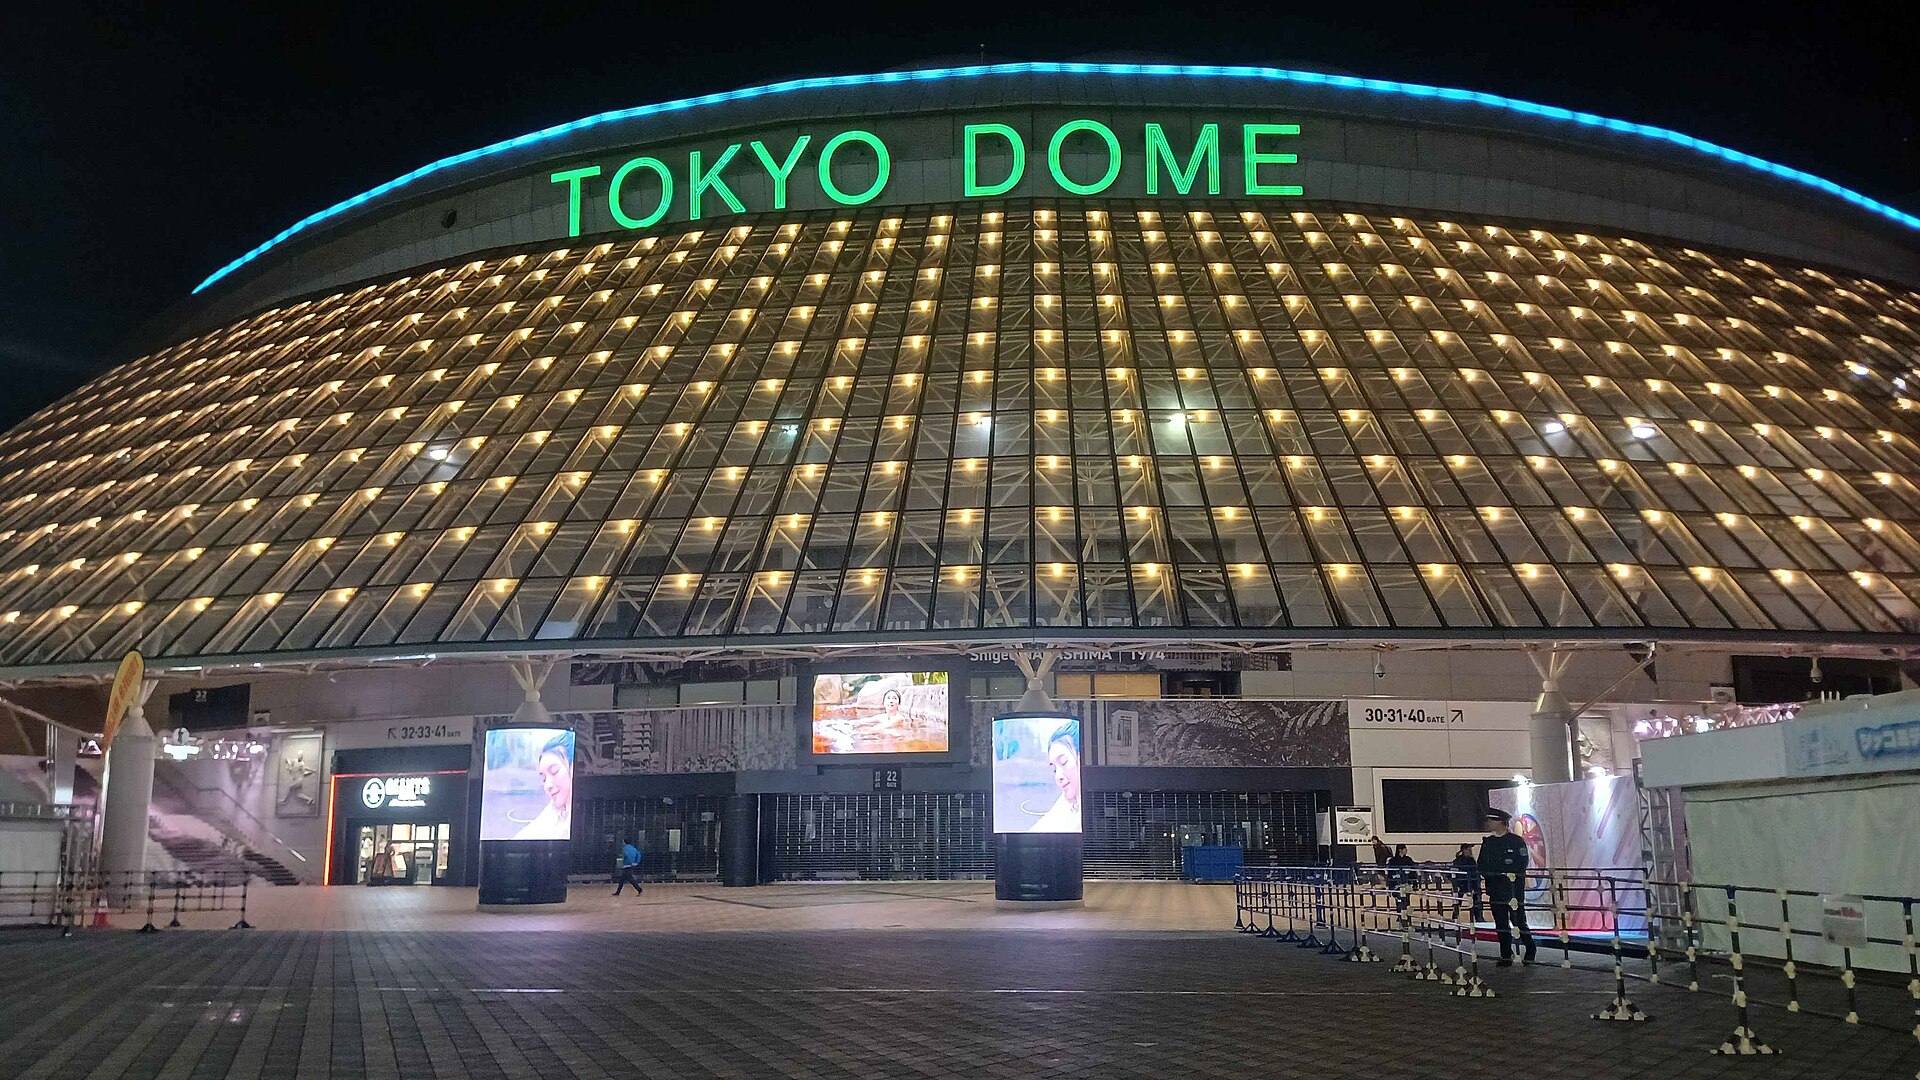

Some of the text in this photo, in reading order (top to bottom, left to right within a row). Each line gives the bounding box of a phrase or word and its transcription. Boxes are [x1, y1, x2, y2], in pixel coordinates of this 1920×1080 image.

[551, 119, 1303, 237] TOKYO DOME
[1025, 650, 1112, 661] ASHIMA
[1130, 650, 1166, 661] 1974
[887, 771, 897, 781] 22
